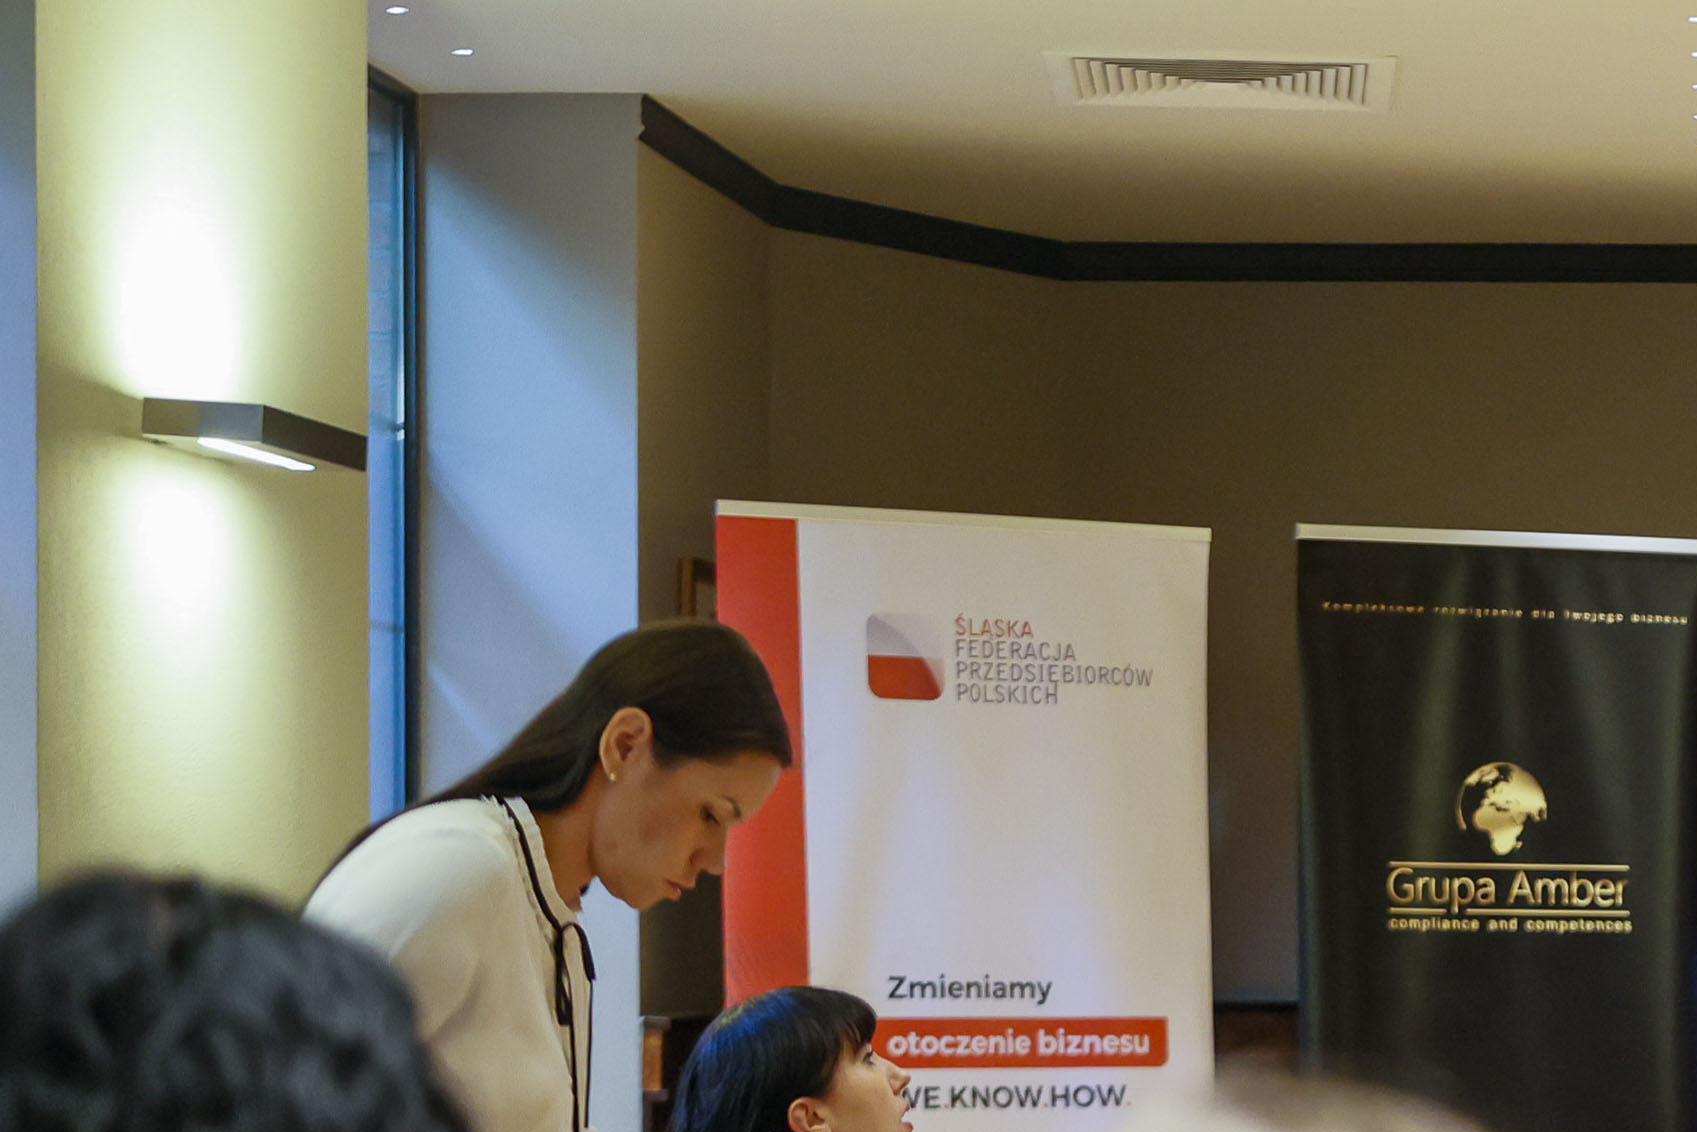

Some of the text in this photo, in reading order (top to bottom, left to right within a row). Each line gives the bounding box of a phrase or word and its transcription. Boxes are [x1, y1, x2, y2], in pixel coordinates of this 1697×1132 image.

[955, 637, 1077, 662] FEDERACJA
[955, 660, 1154, 688] PRZEDSIĘBIORCÓW
[956, 682, 1059, 705] POLSKICH
[1386, 867, 1630, 914] Grupa Amber
[1388, 917, 1633, 935] compliance and competences
[887, 974, 1053, 1005] Zmieniamy
[887, 1028, 1151, 1056] otoczenie biznesu
